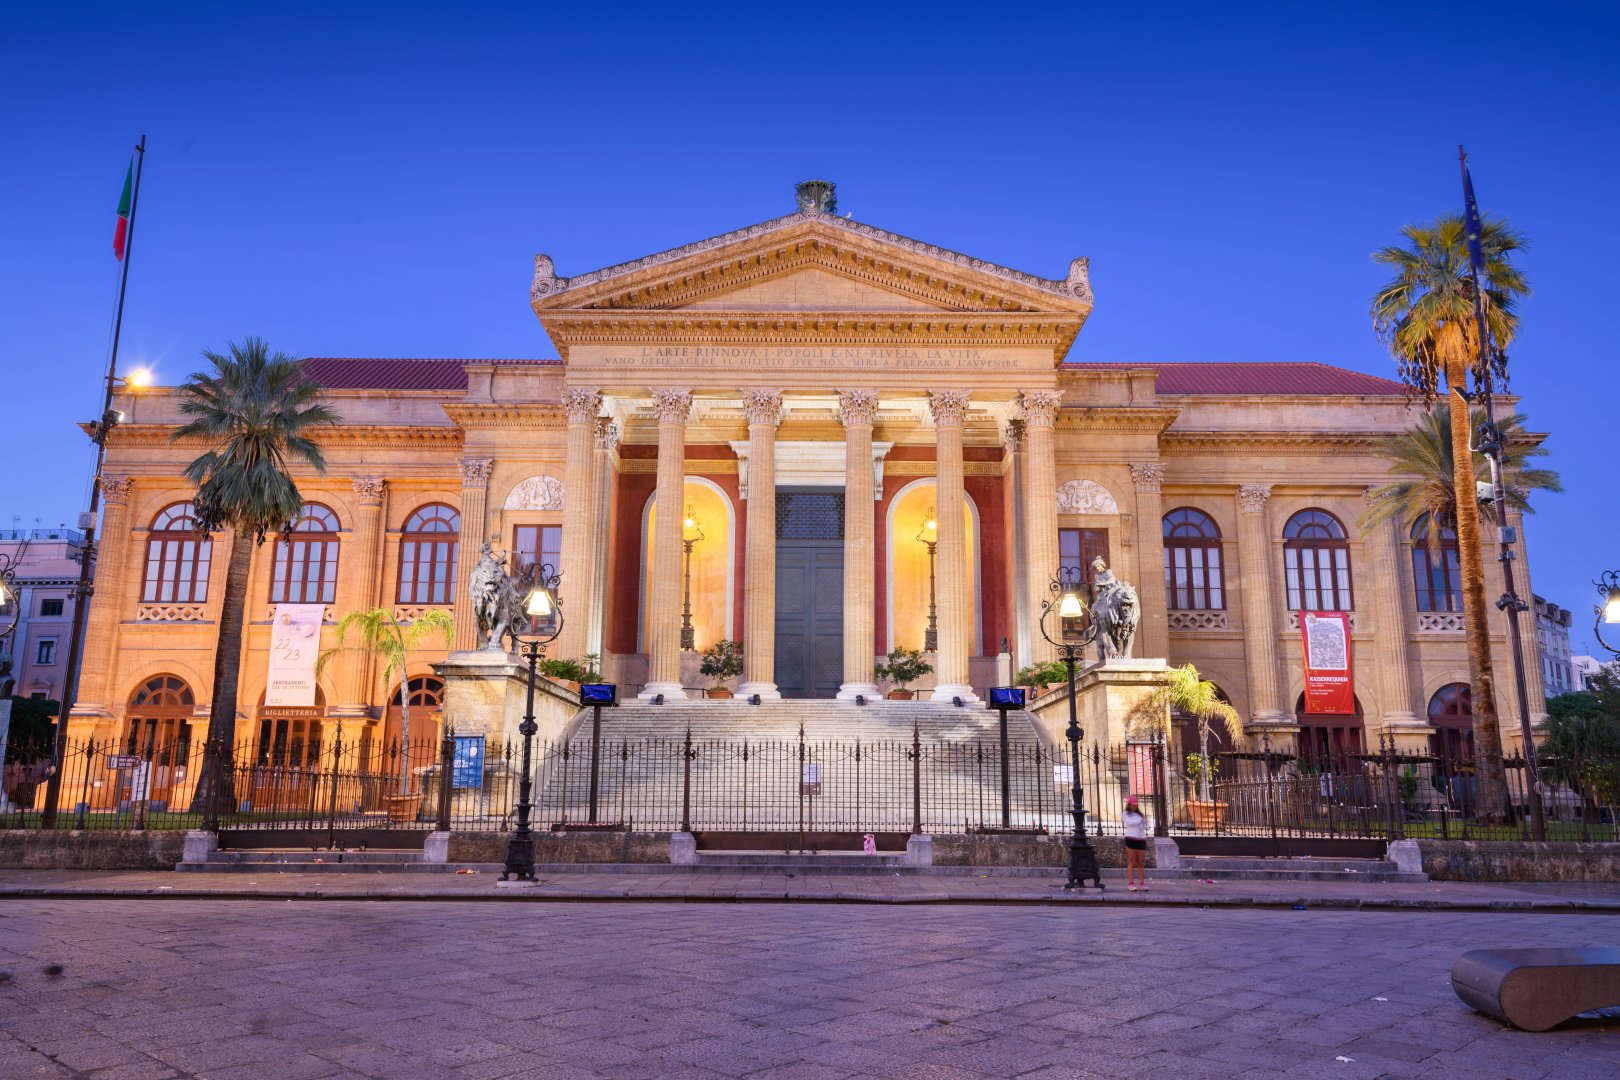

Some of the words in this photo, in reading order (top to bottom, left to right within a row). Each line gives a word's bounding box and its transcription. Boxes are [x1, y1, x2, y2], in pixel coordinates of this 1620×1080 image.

[696, 348, 757, 357] RINNOVA
[778, 348, 824, 358] POPOLI
[871, 349, 918, 358] RIVELA
[928, 350, 941, 358] LA
[950, 350, 980, 358] VITA
[274, 638, 290, 650] 22
[284, 649, 300, 660] 23
